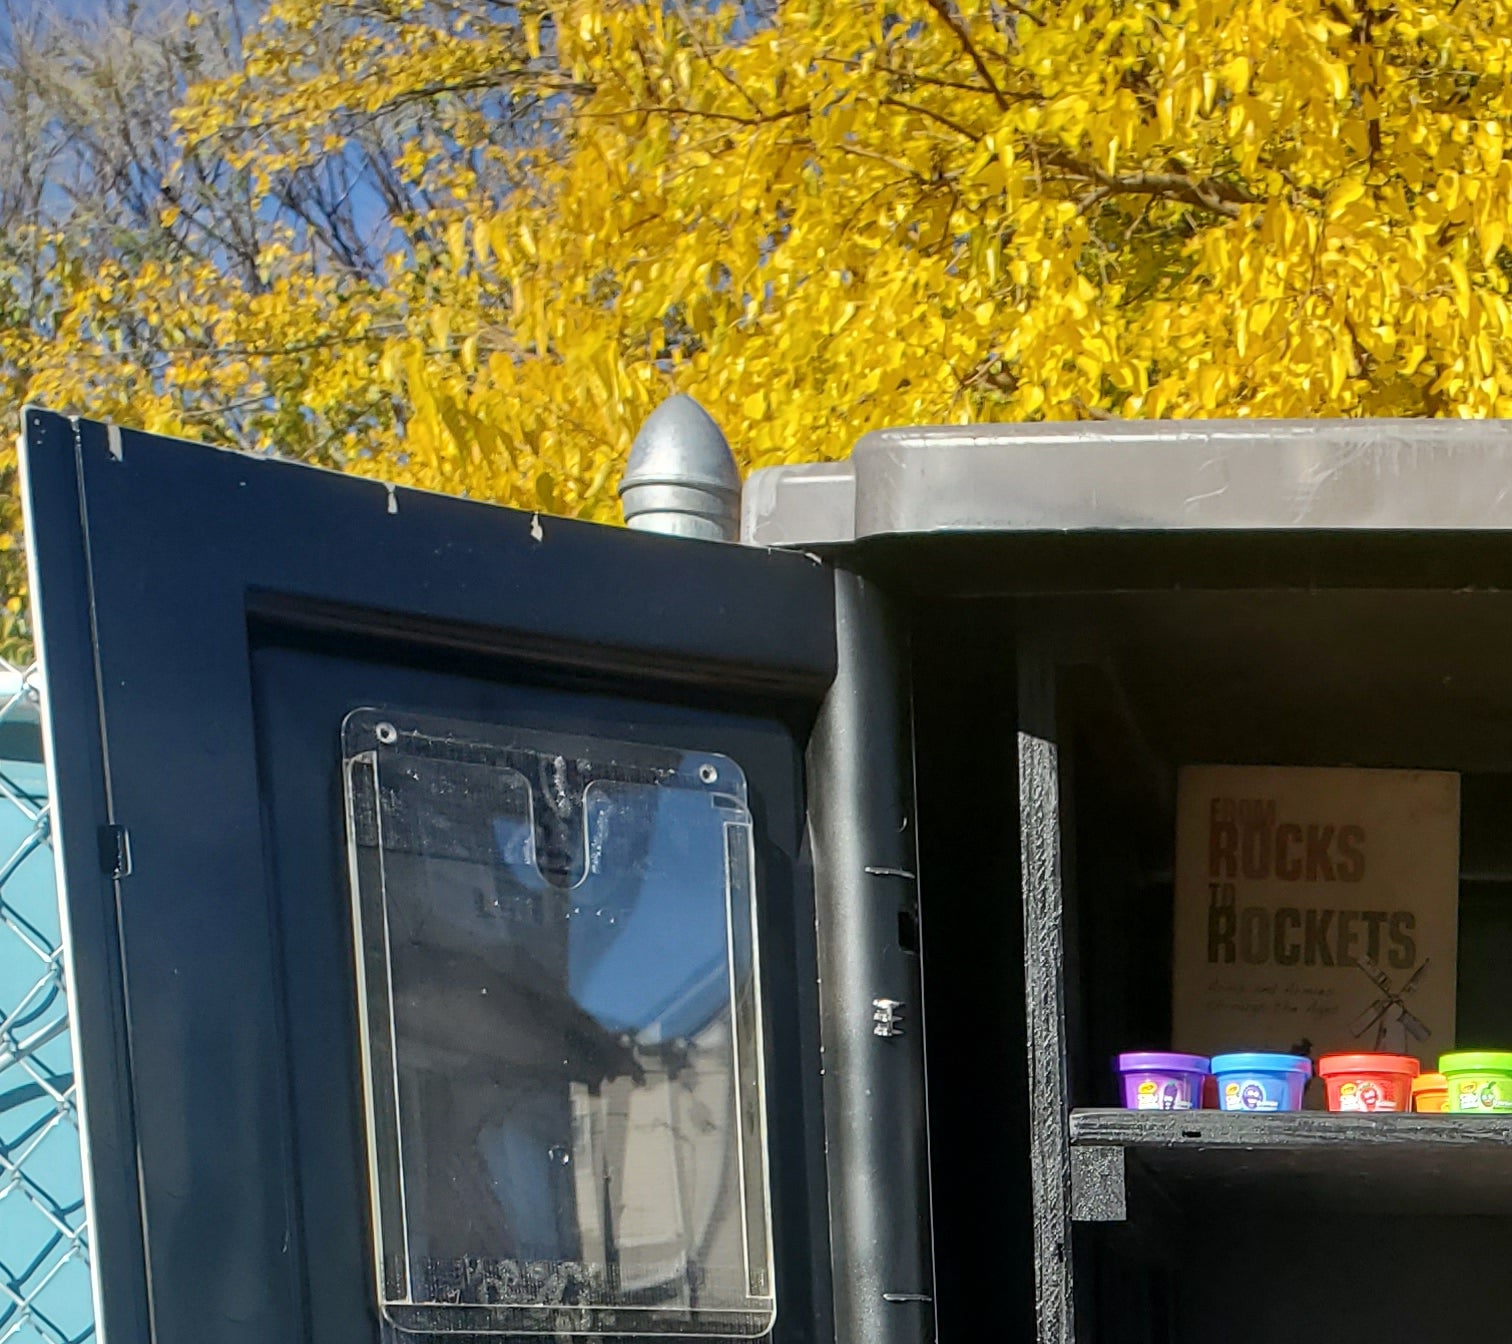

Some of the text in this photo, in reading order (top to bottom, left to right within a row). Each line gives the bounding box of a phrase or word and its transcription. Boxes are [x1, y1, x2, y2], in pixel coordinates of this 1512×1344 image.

[1208, 821, 1366, 882] ROCKS
[1208, 882, 1236, 907] TO
[1207, 906, 1417, 970] ROCKETS
